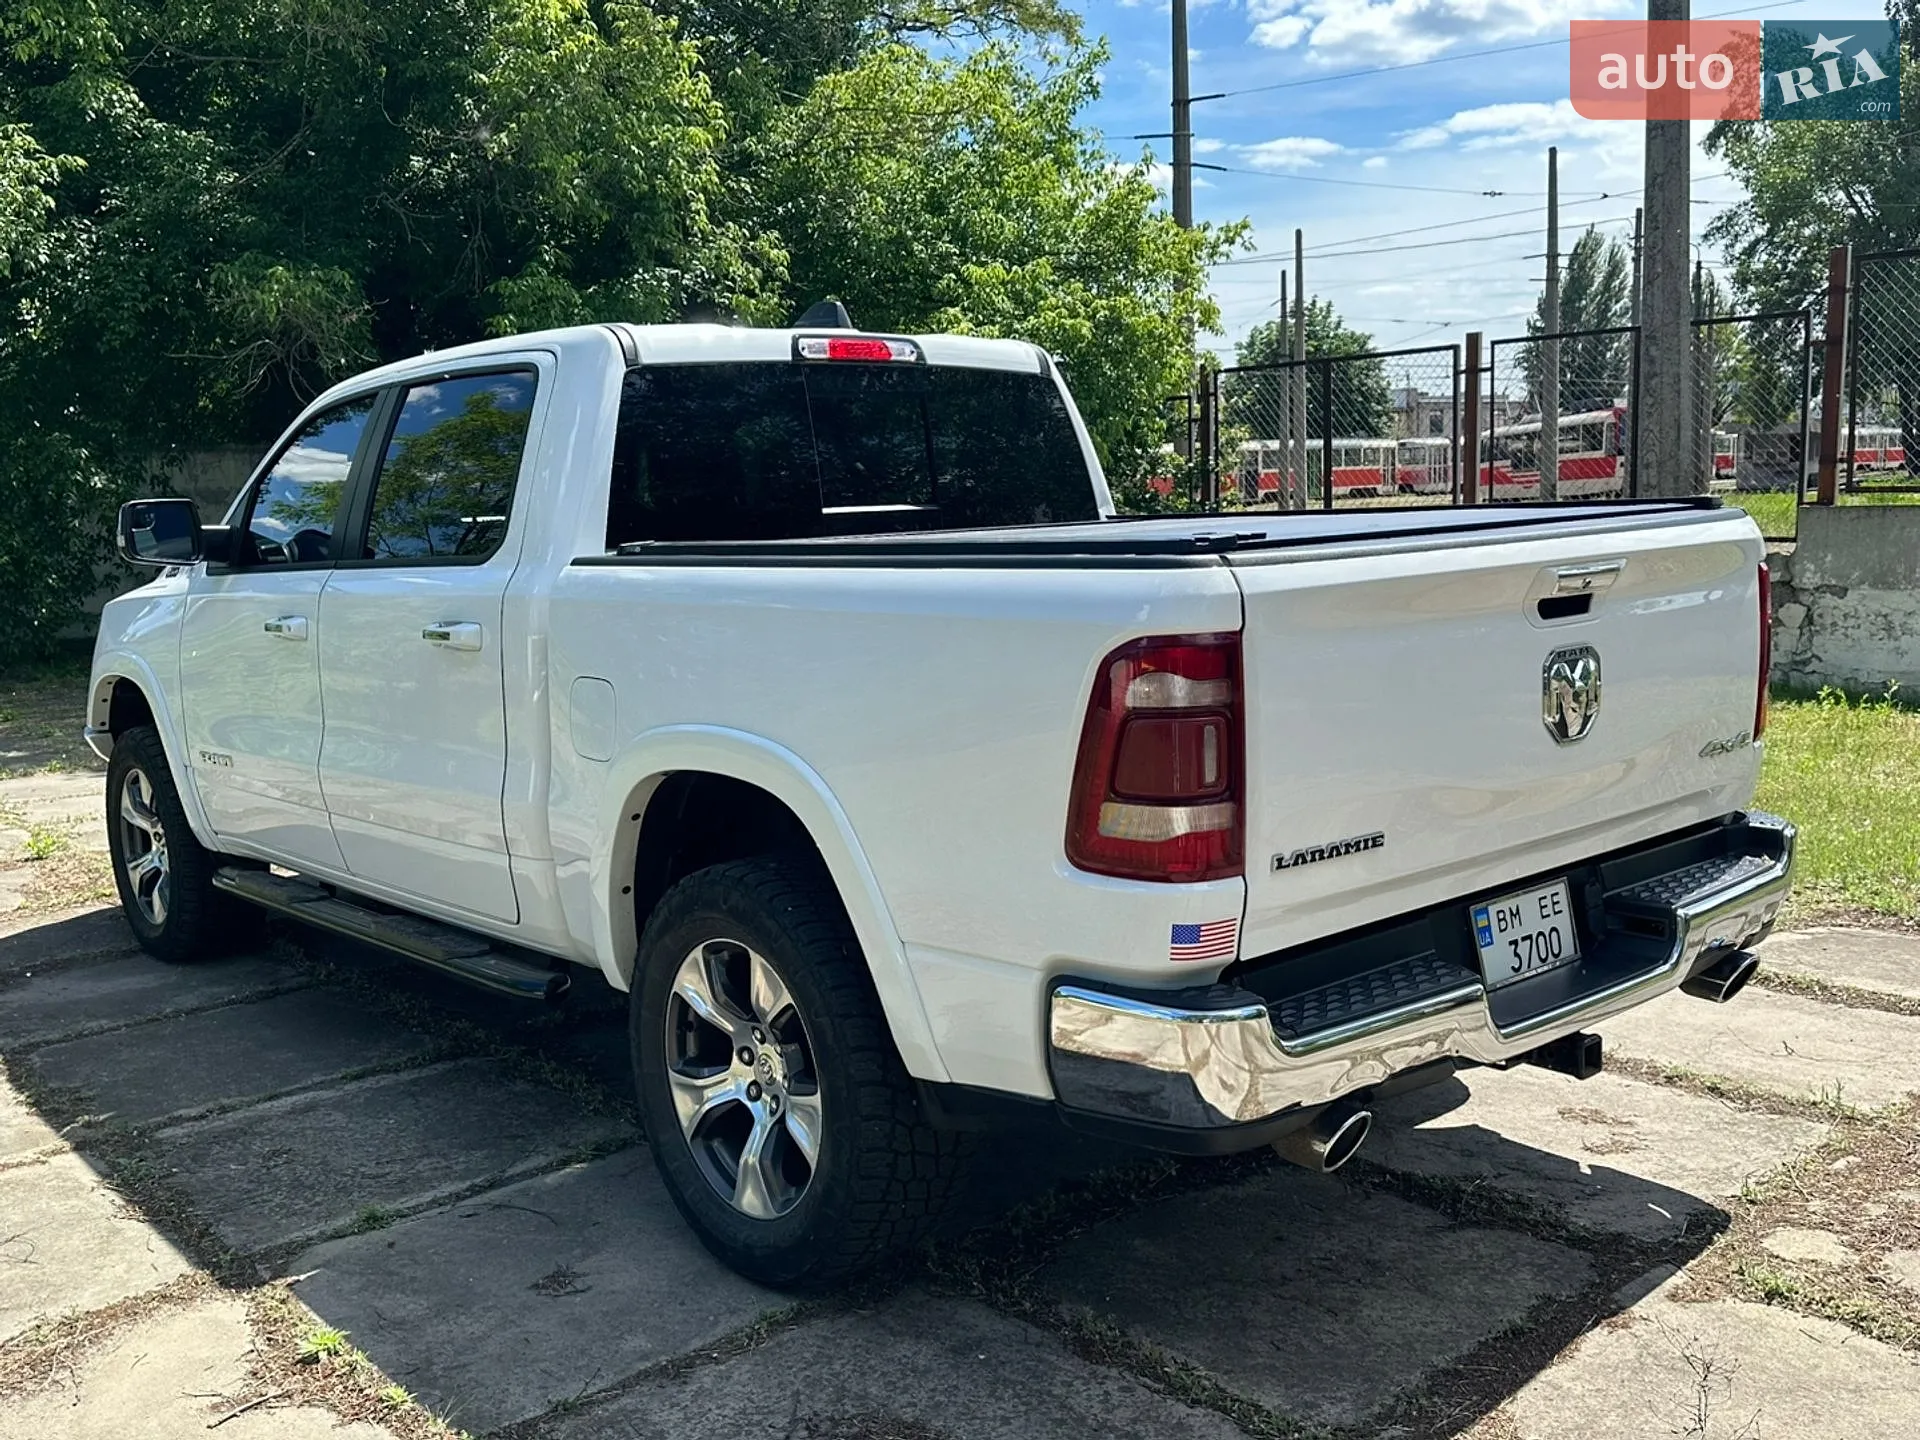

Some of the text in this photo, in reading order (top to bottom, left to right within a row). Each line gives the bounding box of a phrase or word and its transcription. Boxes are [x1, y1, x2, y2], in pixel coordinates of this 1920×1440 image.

[1271, 831, 1385, 871] LARAMIE
[1496, 892, 1564, 933] BM EE
[1478, 933, 1493, 946] UA
[1508, 926, 1563, 973] 3700
